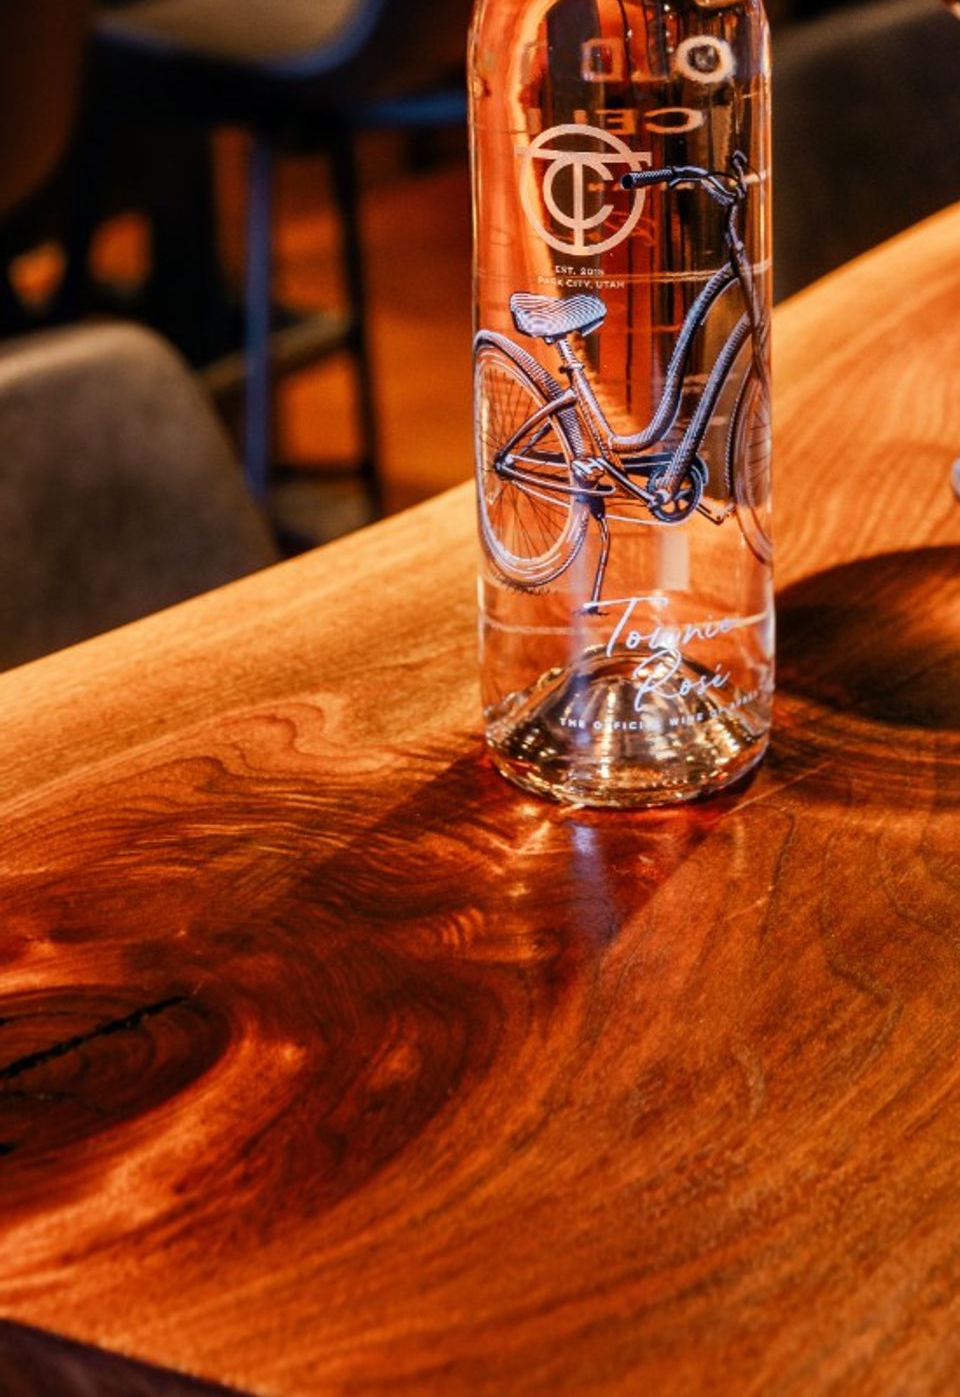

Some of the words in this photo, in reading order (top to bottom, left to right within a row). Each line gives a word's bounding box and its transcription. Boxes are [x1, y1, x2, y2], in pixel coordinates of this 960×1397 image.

[554, 264, 577, 275] EST.
[595, 280, 625, 290] UTAH
[632, 648, 732, 712] Rosé
[559, 717, 585, 729] THE
[593, 720, 660, 731] OFICI
[669, 711, 704, 726] WINE
